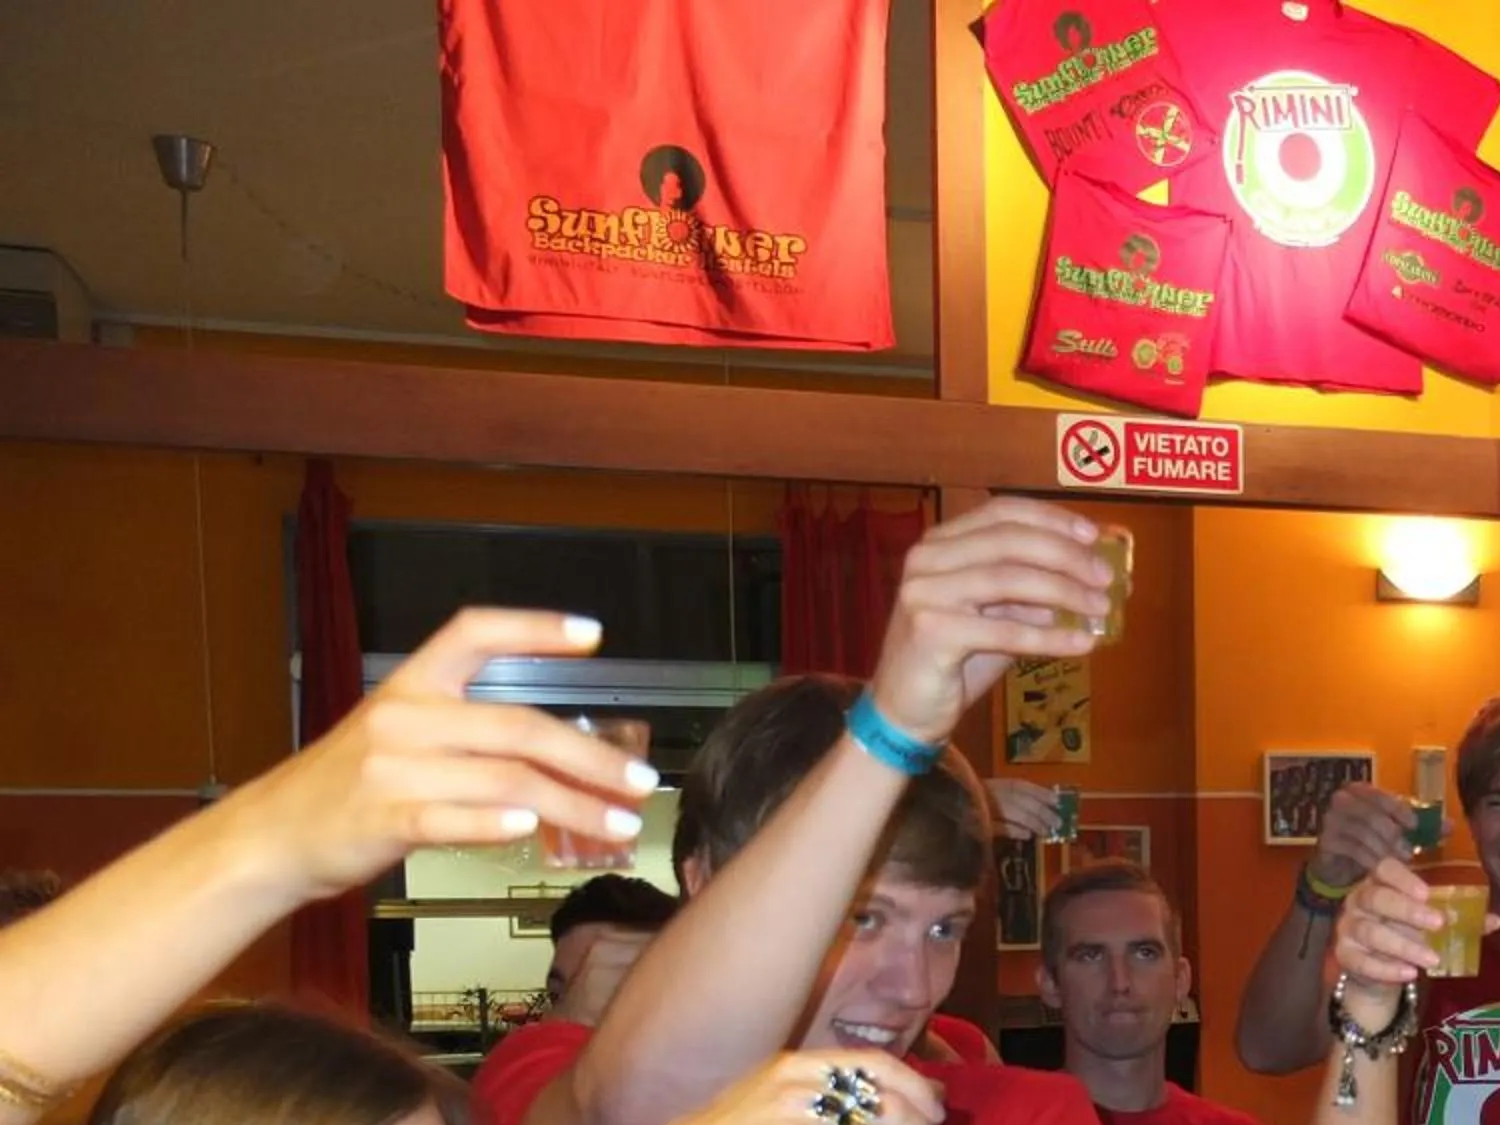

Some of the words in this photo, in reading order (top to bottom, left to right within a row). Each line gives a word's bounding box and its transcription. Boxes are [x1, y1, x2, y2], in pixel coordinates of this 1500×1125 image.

[1231, 93, 1345, 160] RIMINI
[1134, 432, 1229, 457] VIETATO
[1133, 457, 1232, 481] FUMARE
